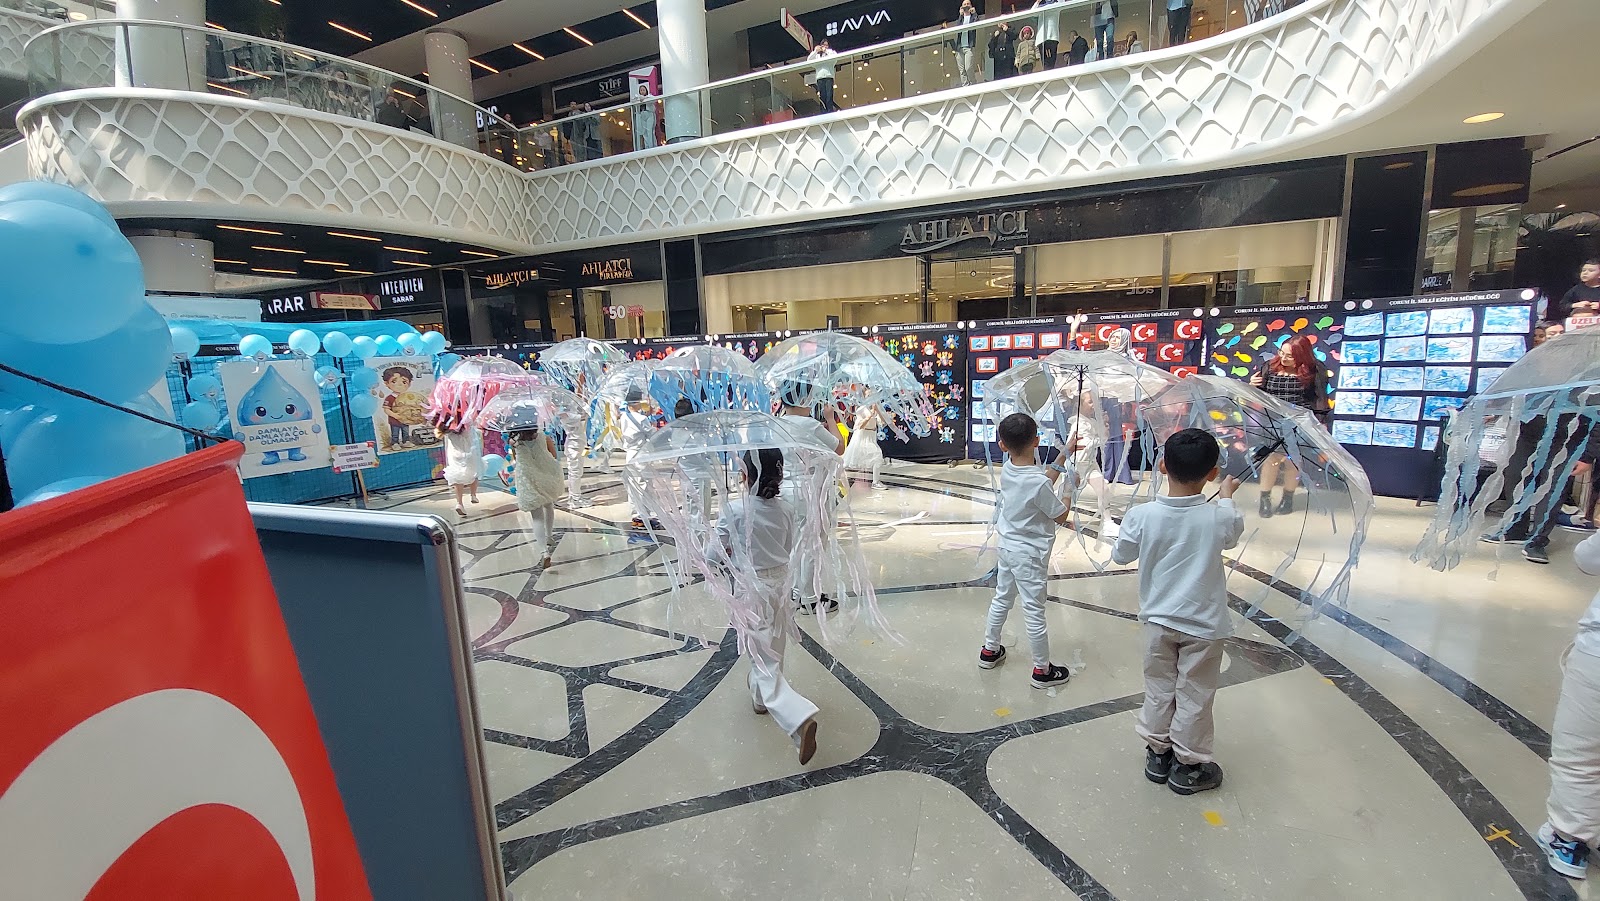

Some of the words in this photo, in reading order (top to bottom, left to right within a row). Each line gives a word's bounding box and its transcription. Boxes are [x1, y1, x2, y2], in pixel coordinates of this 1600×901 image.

[840, 10, 892, 34] AVVA
[900, 209, 1028, 248] AHLATCI
[581, 258, 631, 276] AHLATCI
[380, 277, 424, 296] INTERVIEW
[391, 295, 415, 304] SARAR
